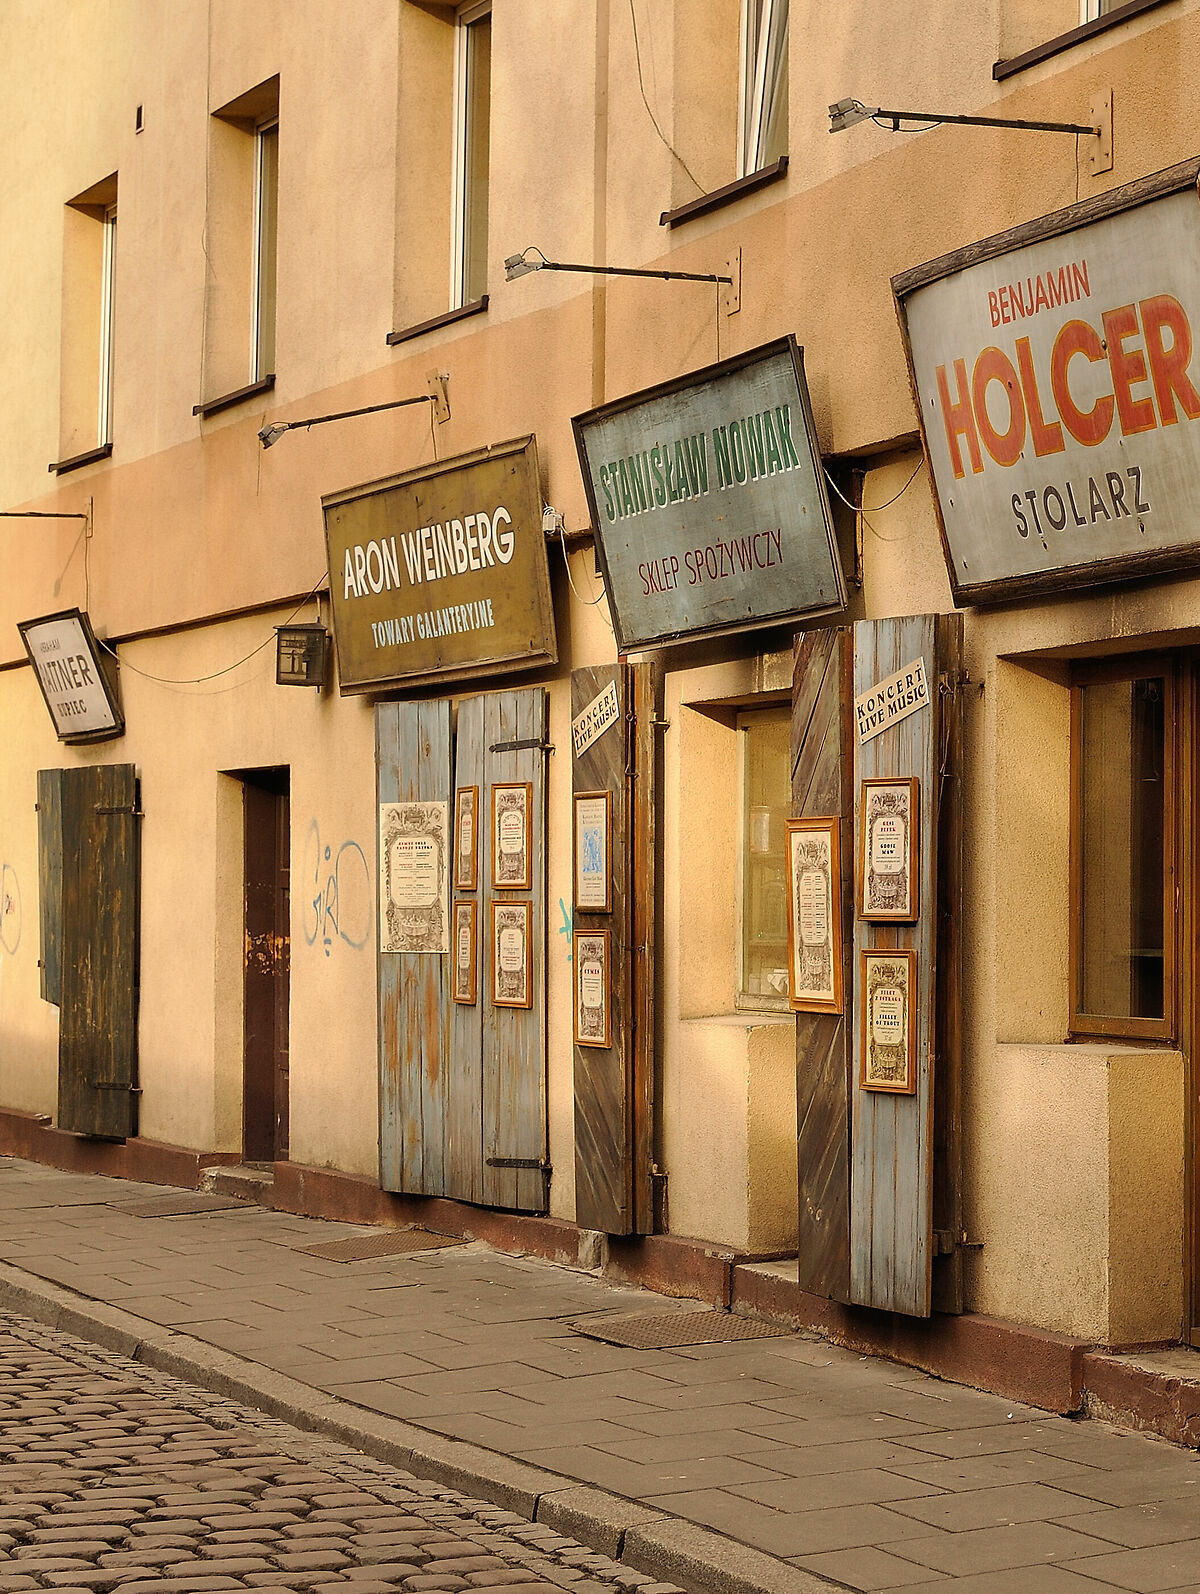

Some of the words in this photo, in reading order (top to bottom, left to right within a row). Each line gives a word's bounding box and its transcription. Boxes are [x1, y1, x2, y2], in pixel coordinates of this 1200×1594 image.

[988, 259, 1091, 327] BENJAMIN
[600, 432, 709, 524] STANISŁAW
[713, 404, 801, 490] NOWAK
[1011, 466, 1150, 539] STOLARZ
[344, 537, 400, 600] ARON
[401, 506, 515, 585] WEINBERG
[638, 556, 679, 596] SKLEP
[684, 528, 783, 585] SPOŻYWCZY
[371, 615, 415, 648] TOWARY
[416, 598, 495, 639] GALANTERYJNE
[574, 690, 614, 738] KONCERT
[857, 667, 922, 719] KONCERT
[859, 709, 885, 735] LIVE
[887, 685, 925, 717] MUSIC
[575, 727, 592, 750] LIVE
[593, 703, 616, 732] MUSIC
